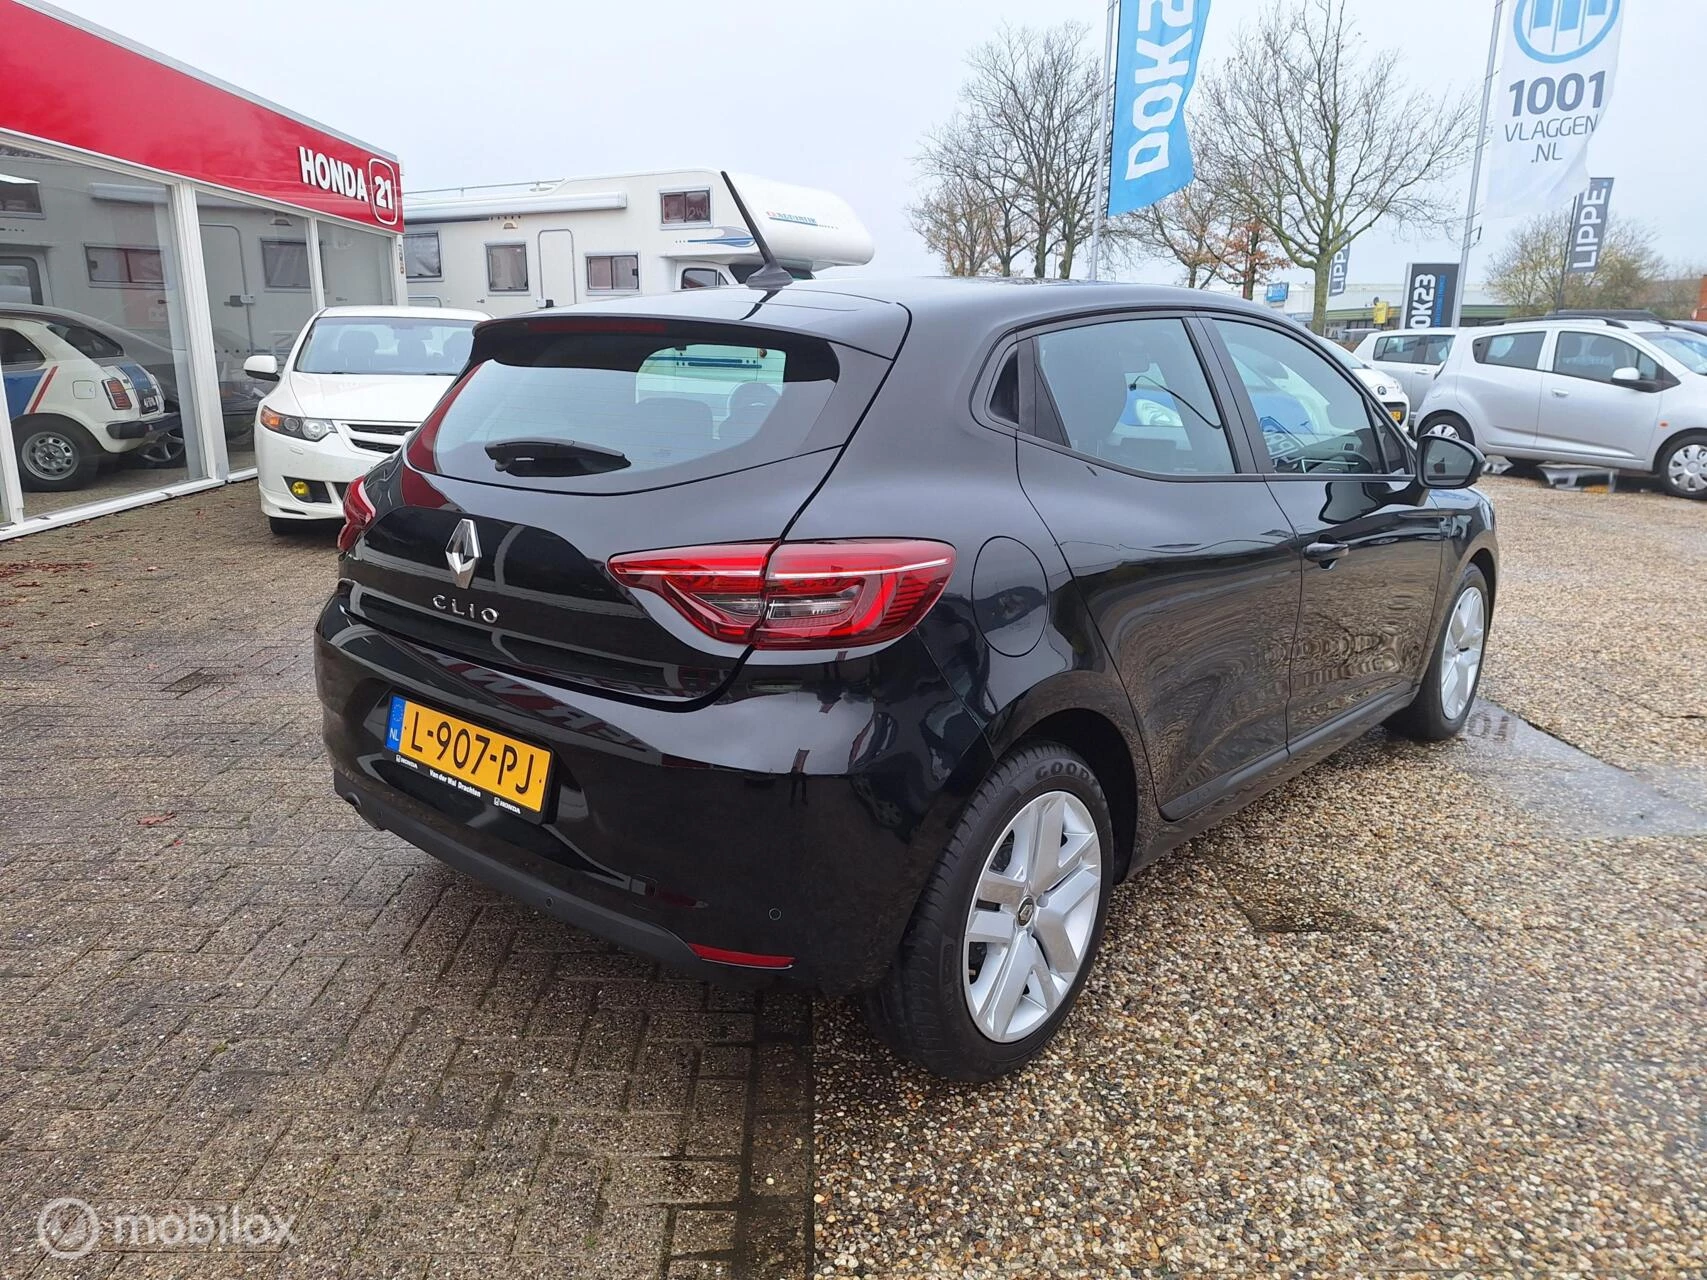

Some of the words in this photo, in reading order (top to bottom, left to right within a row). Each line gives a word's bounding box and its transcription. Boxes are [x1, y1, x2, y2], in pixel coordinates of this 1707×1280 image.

[1125, 0, 1193, 180] DOK2
[1509, 70, 1606, 117] 1001
[1505, 114, 1599, 142] VLAGGEN
[1531, 142, 1563, 163] .NL
[299, 145, 369, 202] HONDA
[374, 175, 393, 210] 21
[1410, 273, 1436, 328] OK23
[432, 594, 499, 624] CLIO
[389, 727, 400, 742] NL
[411, 711, 535, 794] L-907-PJ
